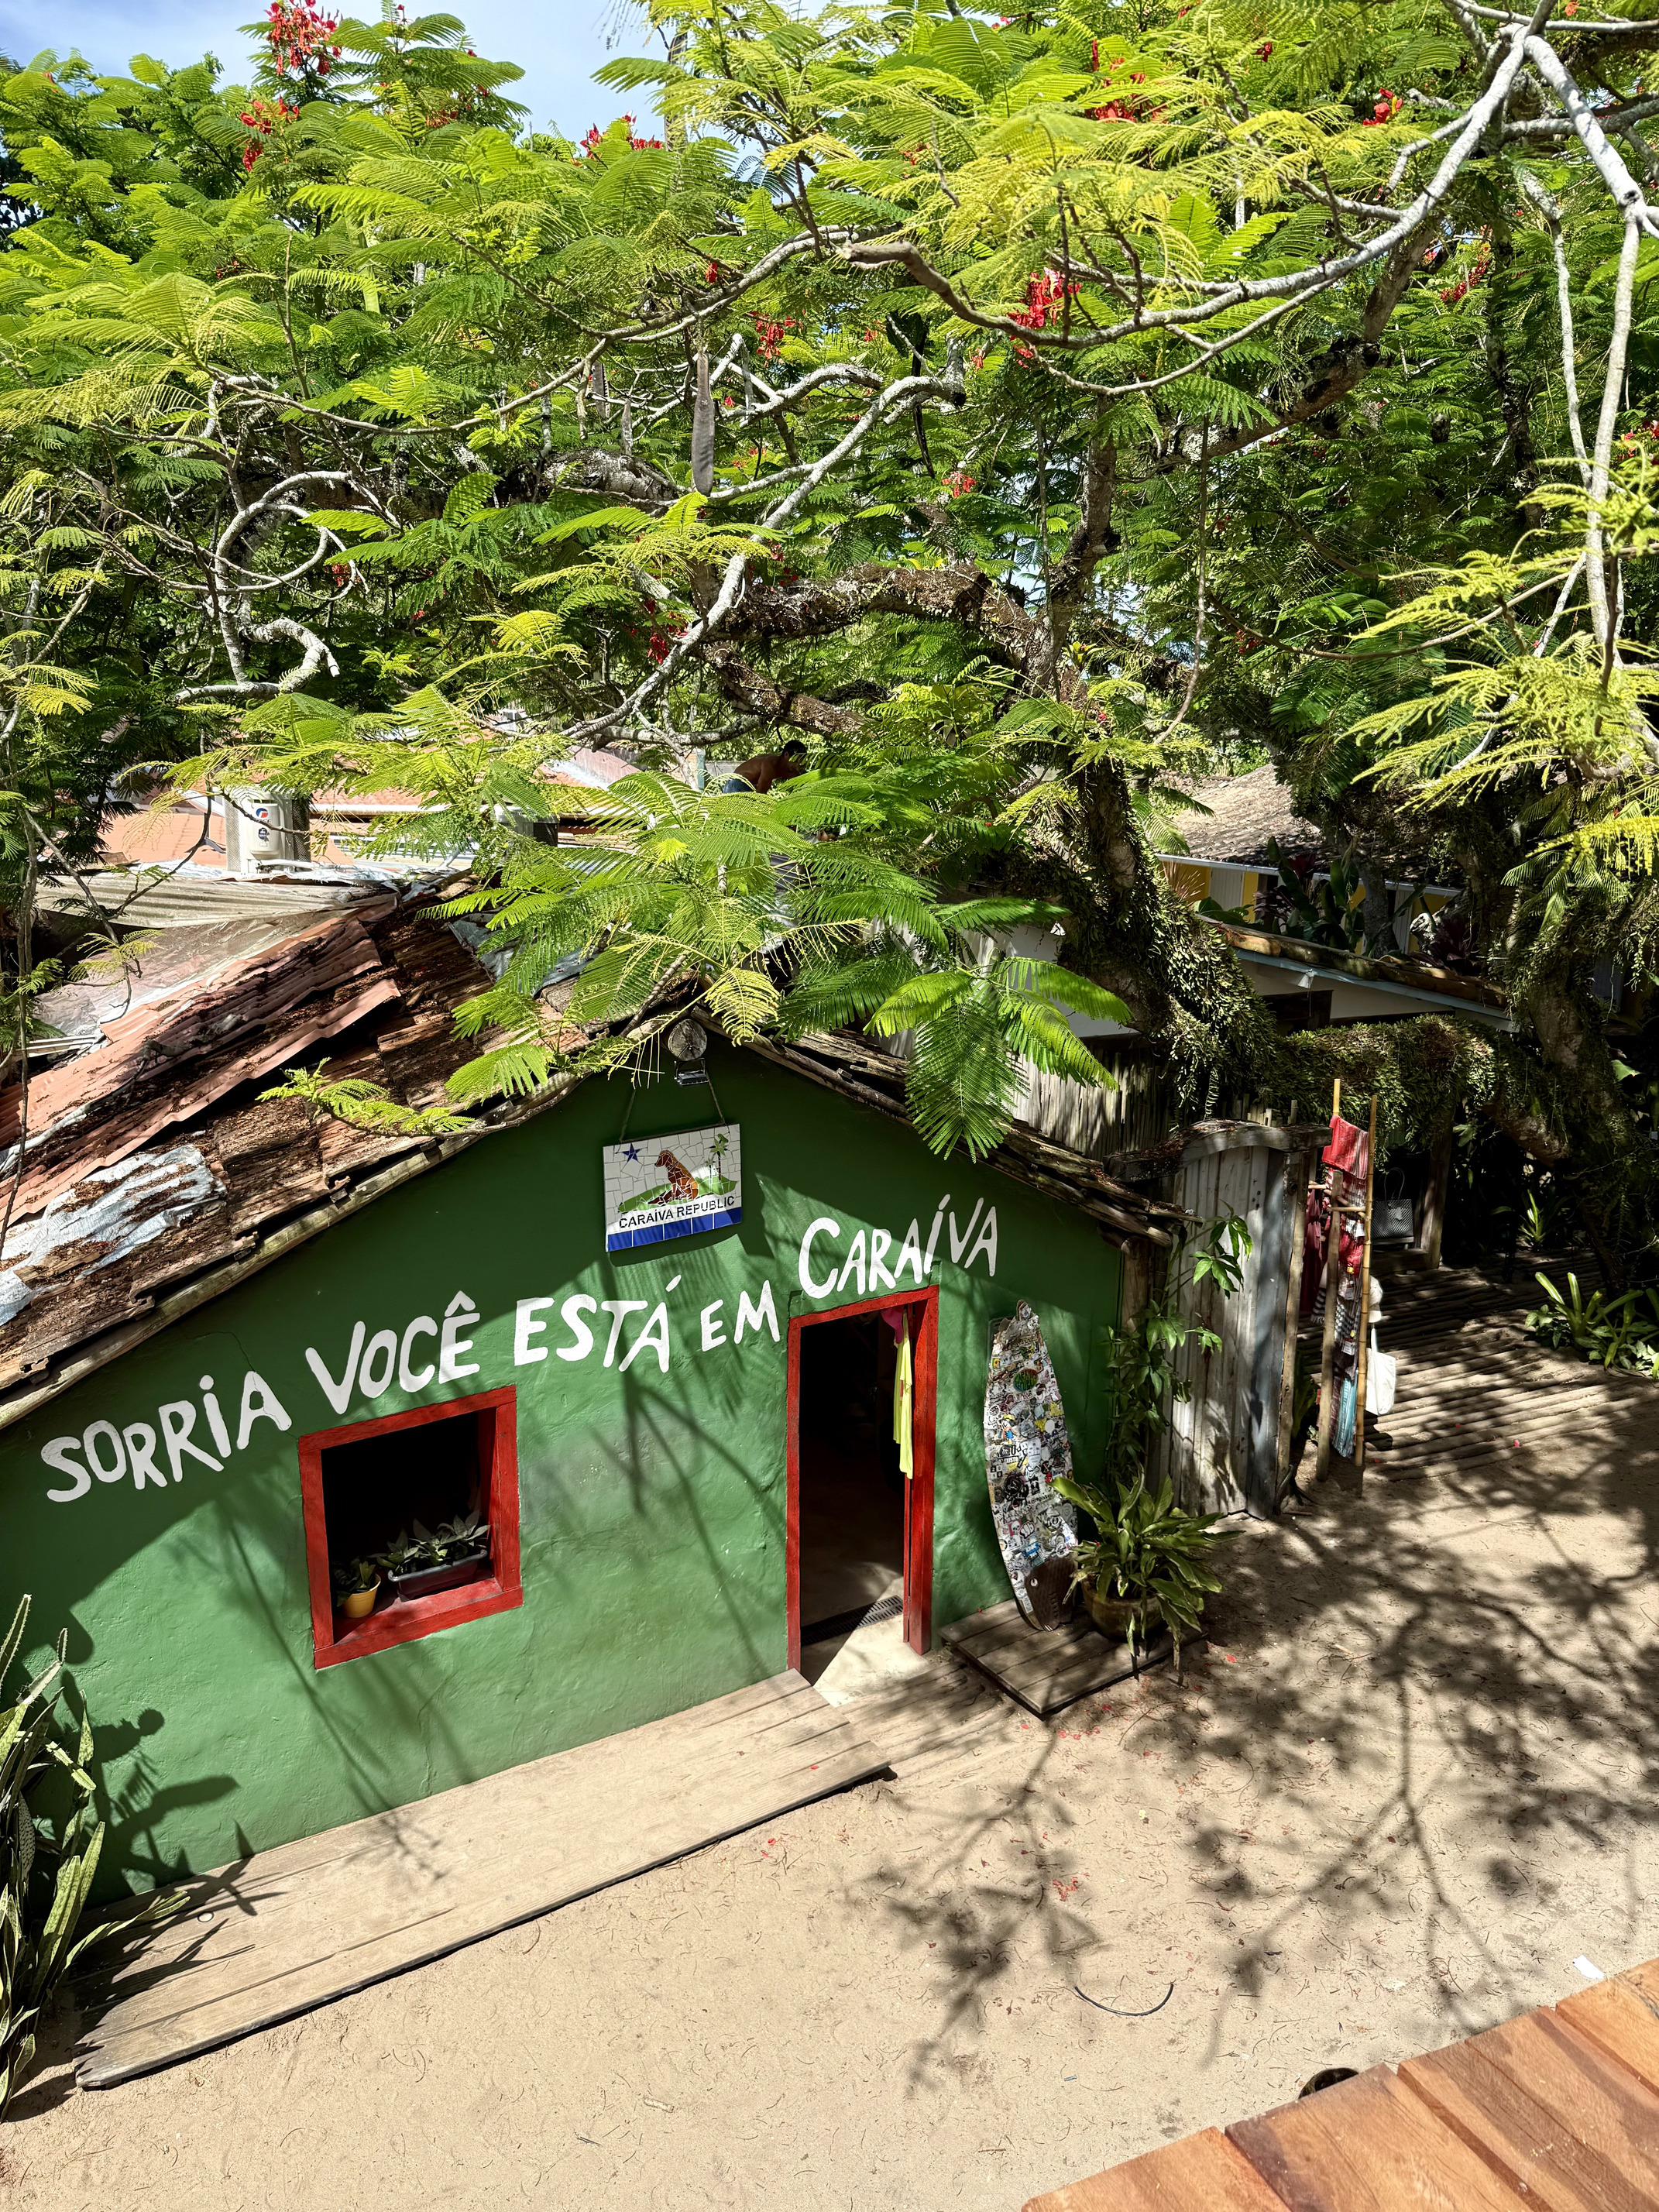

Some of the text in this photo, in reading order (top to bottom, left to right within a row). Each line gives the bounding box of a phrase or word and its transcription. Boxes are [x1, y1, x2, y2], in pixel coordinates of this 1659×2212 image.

[619, 1196, 735, 1228] CARAÍVA REPUBLIC
[305, 1290, 481, 1415] VOCÊ
[514, 1274, 682, 1373] ESTÁ
[700, 1279, 781, 1352] EM
[798, 1194, 998, 1300] CARAÍVA
